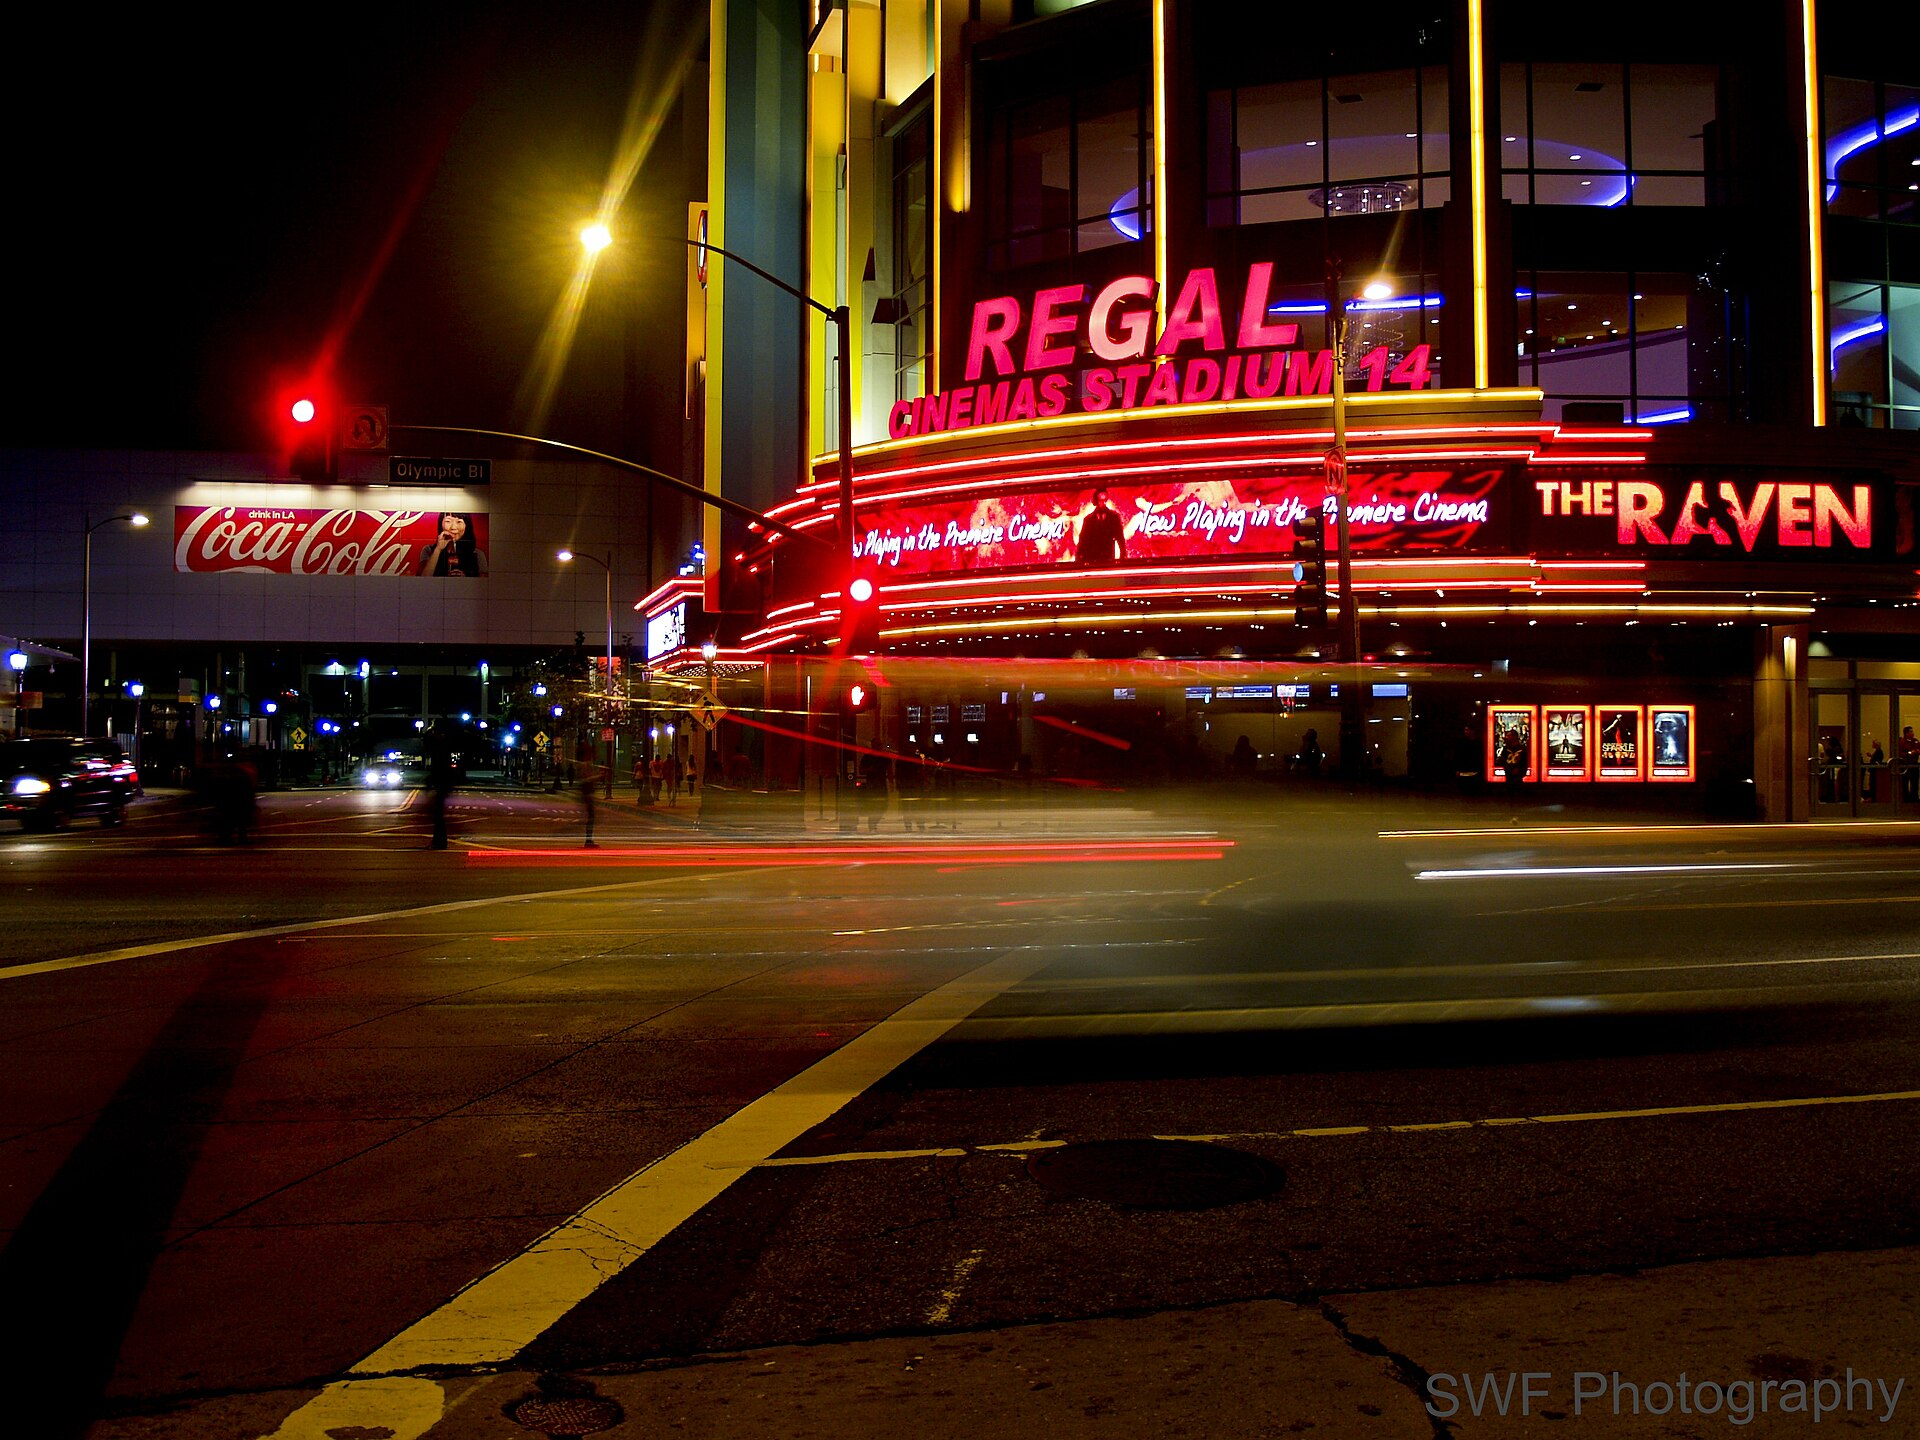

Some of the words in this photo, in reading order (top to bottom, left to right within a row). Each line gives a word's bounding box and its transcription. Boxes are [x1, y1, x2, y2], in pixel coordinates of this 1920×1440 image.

[964, 261, 1298, 382] REGAL
[889, 373, 1067, 440] CINEMAS
[1083, 348, 1333, 413] STADIUM
[1359, 343, 1432, 392] 14
[397, 463, 461, 480] Olympic
[248, 509, 271, 519] drink
[282, 511, 295, 519] LA
[864, 529, 902, 566] Playing
[903, 526, 915, 552] in
[918, 523, 941, 551] the
[944, 518, 1004, 547] Premiere
[1008, 514, 1064, 542] Cinema
[1133, 501, 1176, 534] Now
[1182, 501, 1246, 543] Playing
[1251, 498, 1269, 527] in
[1322, 495, 1405, 525] Prmiere
[1413, 492, 1488, 523] Cinema
[1536, 481, 1614, 516] THE
[1617, 481, 1872, 553] RAVEN
[175, 506, 424, 577] Coca-Cola
[1602, 743, 1635, 752] SPARKLE
